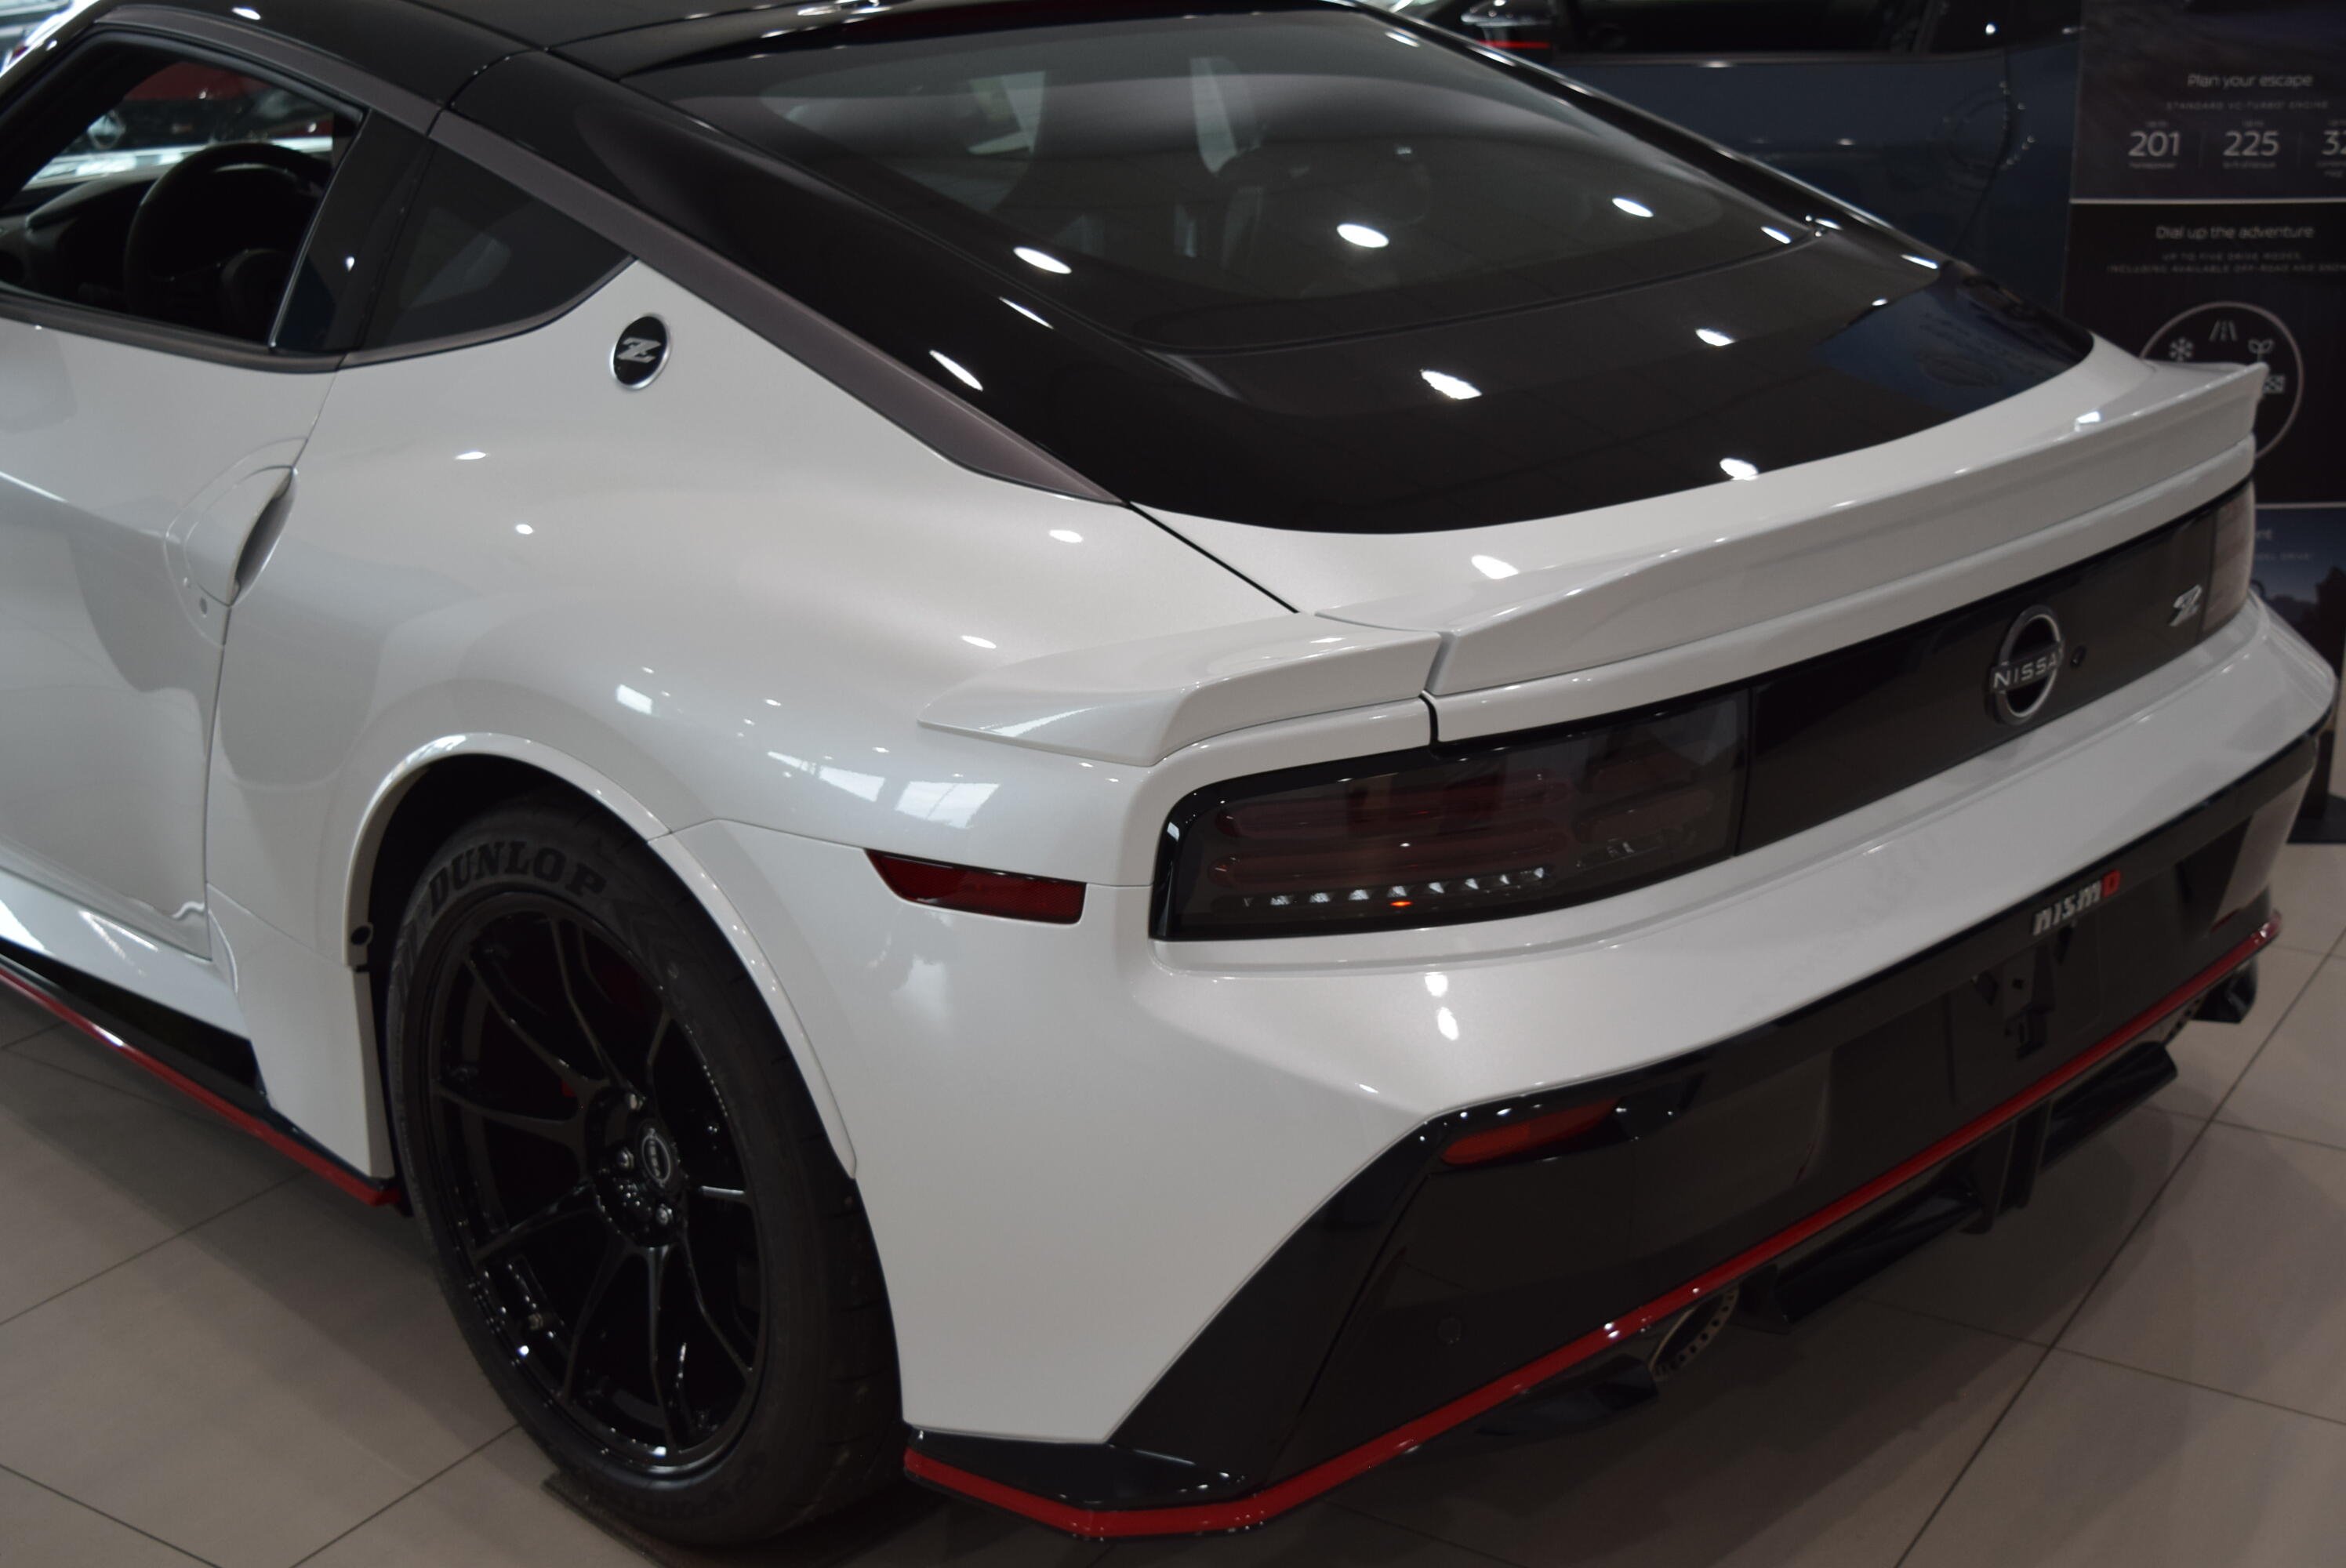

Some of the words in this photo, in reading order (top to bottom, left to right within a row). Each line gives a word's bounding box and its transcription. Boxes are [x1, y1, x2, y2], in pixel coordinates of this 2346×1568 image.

[2127, 130, 2181, 157] 201
[2223, 130, 2279, 156] 225
[616, 336, 662, 364] Z
[1993, 644, 2064, 690] NISSA
[429, 840, 608, 917] DUNLOP
